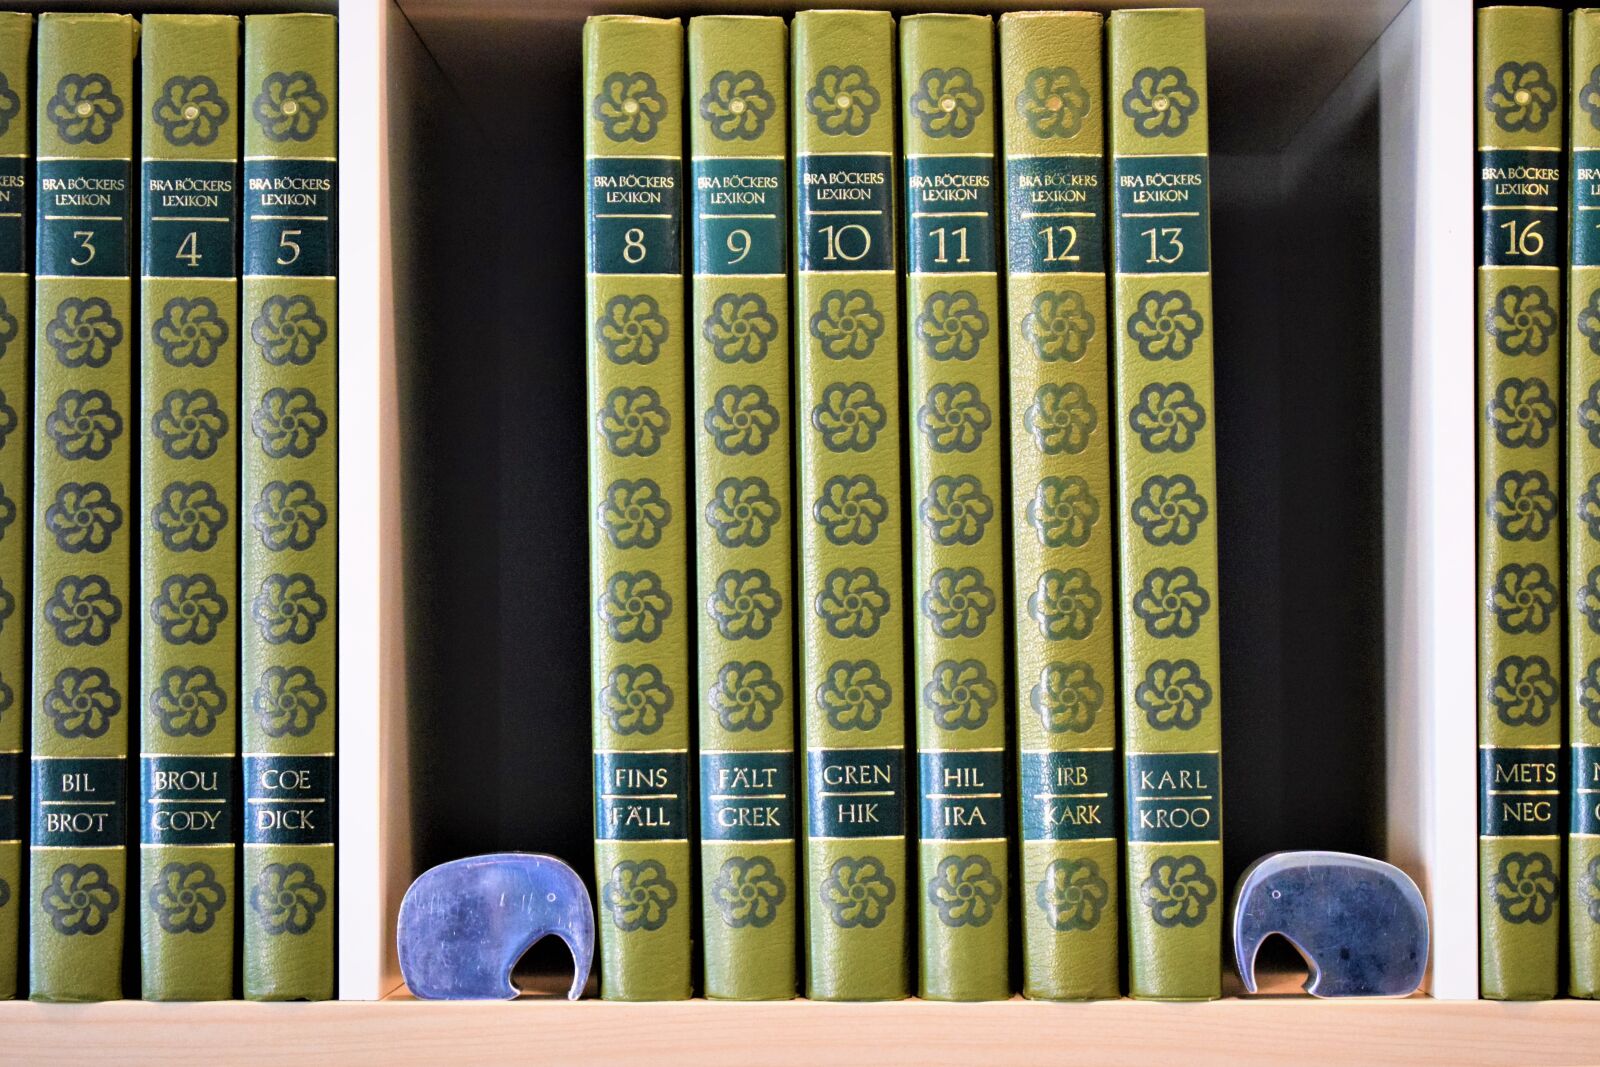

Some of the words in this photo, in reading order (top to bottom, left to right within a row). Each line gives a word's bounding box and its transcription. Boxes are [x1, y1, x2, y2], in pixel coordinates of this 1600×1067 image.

[594, 176, 617, 187] BRA
[619, 174, 674, 188] BÖCKERS
[698, 176, 721, 188] BRA
[724, 175, 778, 188] BÖCKERS
[804, 173, 827, 184] BRA
[830, 172, 884, 185] BÖCKERS
[910, 176, 932, 187] BRA
[935, 174, 989, 187] BÖCKERS
[1020, 176, 1042, 187] BRA
[1121, 176, 1144, 186] BRA
[1146, 174, 1201, 186] BÖCKERS
[1482, 168, 1506, 180] BRA
[1508, 166, 1559, 180] BÖCKERS
[43, 179, 66, 191] BRA
[69, 177, 124, 191] BÖCKERS
[150, 180, 173, 192] BRA
[176, 178, 231, 192] BÖCKERS
[249, 179, 272, 191] BRA
[274, 177, 330, 191] BÖCKERS
[1496, 184, 1548, 195] LEXIKON
[55, 194, 110, 206] LEXIKON
[163, 195, 218, 207] LEXIKON
[262, 194, 316, 205] LEXIKON
[607, 192, 661, 203] LEXIKON
[711, 193, 765, 204] LEXIKON
[817, 188, 871, 200] LEXIKON
[923, 189, 977, 201] LEXIKON
[1032, 190, 1086, 202] LEXIKON
[1133, 190, 1188, 201] LEXIKON
[277, 230, 302, 265] 5
[623, 228, 647, 263] 8
[727, 229, 751, 264] 9
[818, 224, 871, 261] 10
[929, 227, 970, 263] 11
[1039, 226, 1080, 261] 12
[1141, 227, 1184, 263] 13
[1500, 220, 1544, 256] 16
[70, 231, 96, 266] 3
[176, 231, 202, 267] 4
[155, 771, 217, 790] BROU
[262, 770, 310, 789] COE
[615, 768, 668, 788] FINS
[719, 767, 778, 788] FÄLT
[823, 765, 891, 785] GREN
[944, 768, 984, 787] HIL
[1057, 767, 1087, 786] IRB
[1141, 770, 1207, 789] KARL
[1495, 763, 1556, 783] METS
[62, 774, 95, 792] BIL
[153, 811, 221, 831] CODY
[258, 809, 314, 830] DICK
[612, 805, 670, 826] FÄLL
[718, 807, 780, 827] GREK
[838, 804, 879, 823] HIK
[945, 806, 986, 826] IRA
[1045, 805, 1101, 824] KARK
[1140, 808, 1210, 828] KROO
[1503, 802, 1551, 821] NEG
[47, 813, 108, 832] BROT
